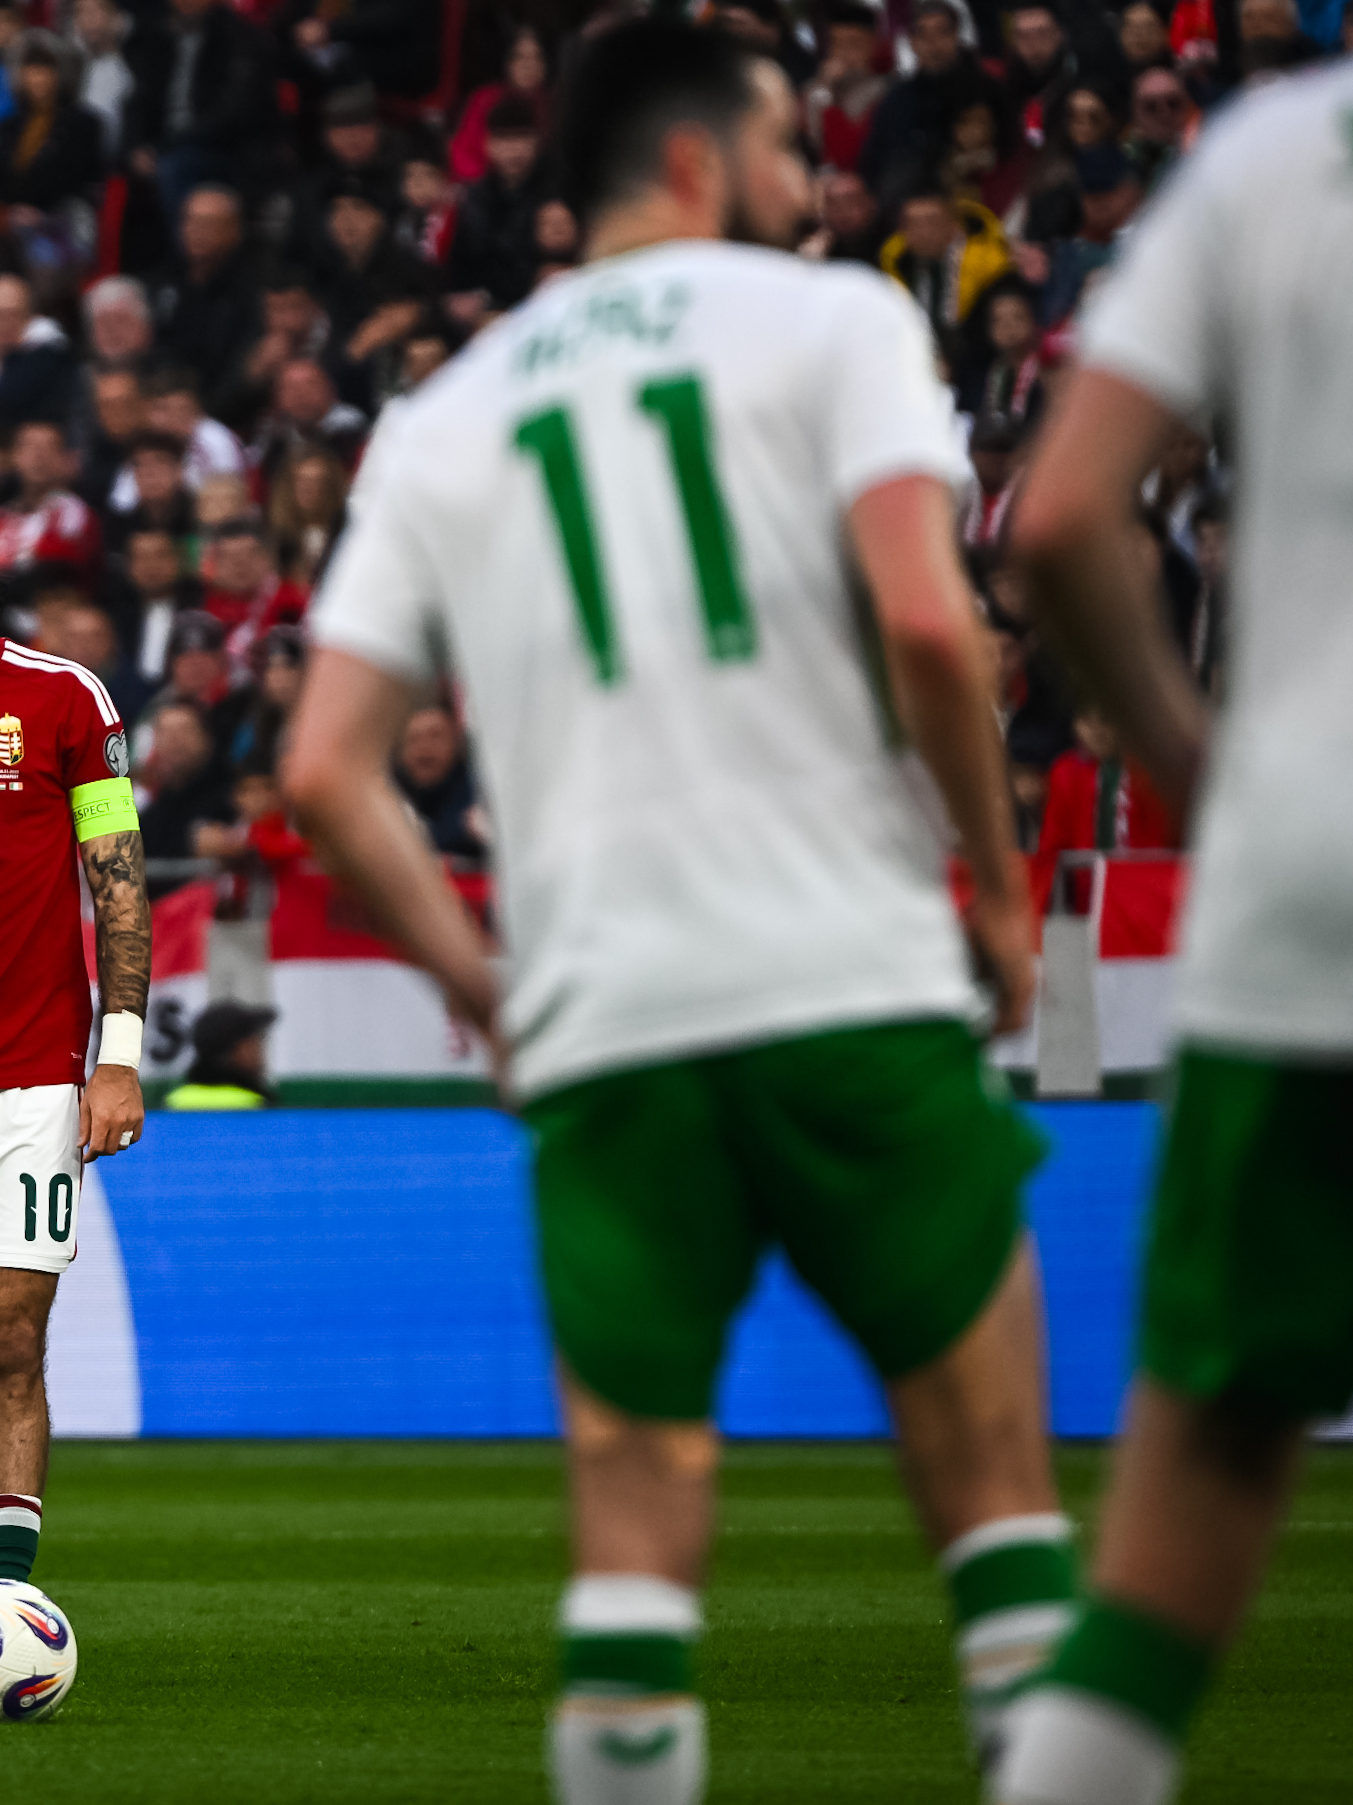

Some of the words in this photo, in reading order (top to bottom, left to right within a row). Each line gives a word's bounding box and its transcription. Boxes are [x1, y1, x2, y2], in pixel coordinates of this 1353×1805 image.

[515, 378, 754, 686] 11
[72, 801, 110, 821] ESPECT
[19, 1172, 73, 1242] 10
